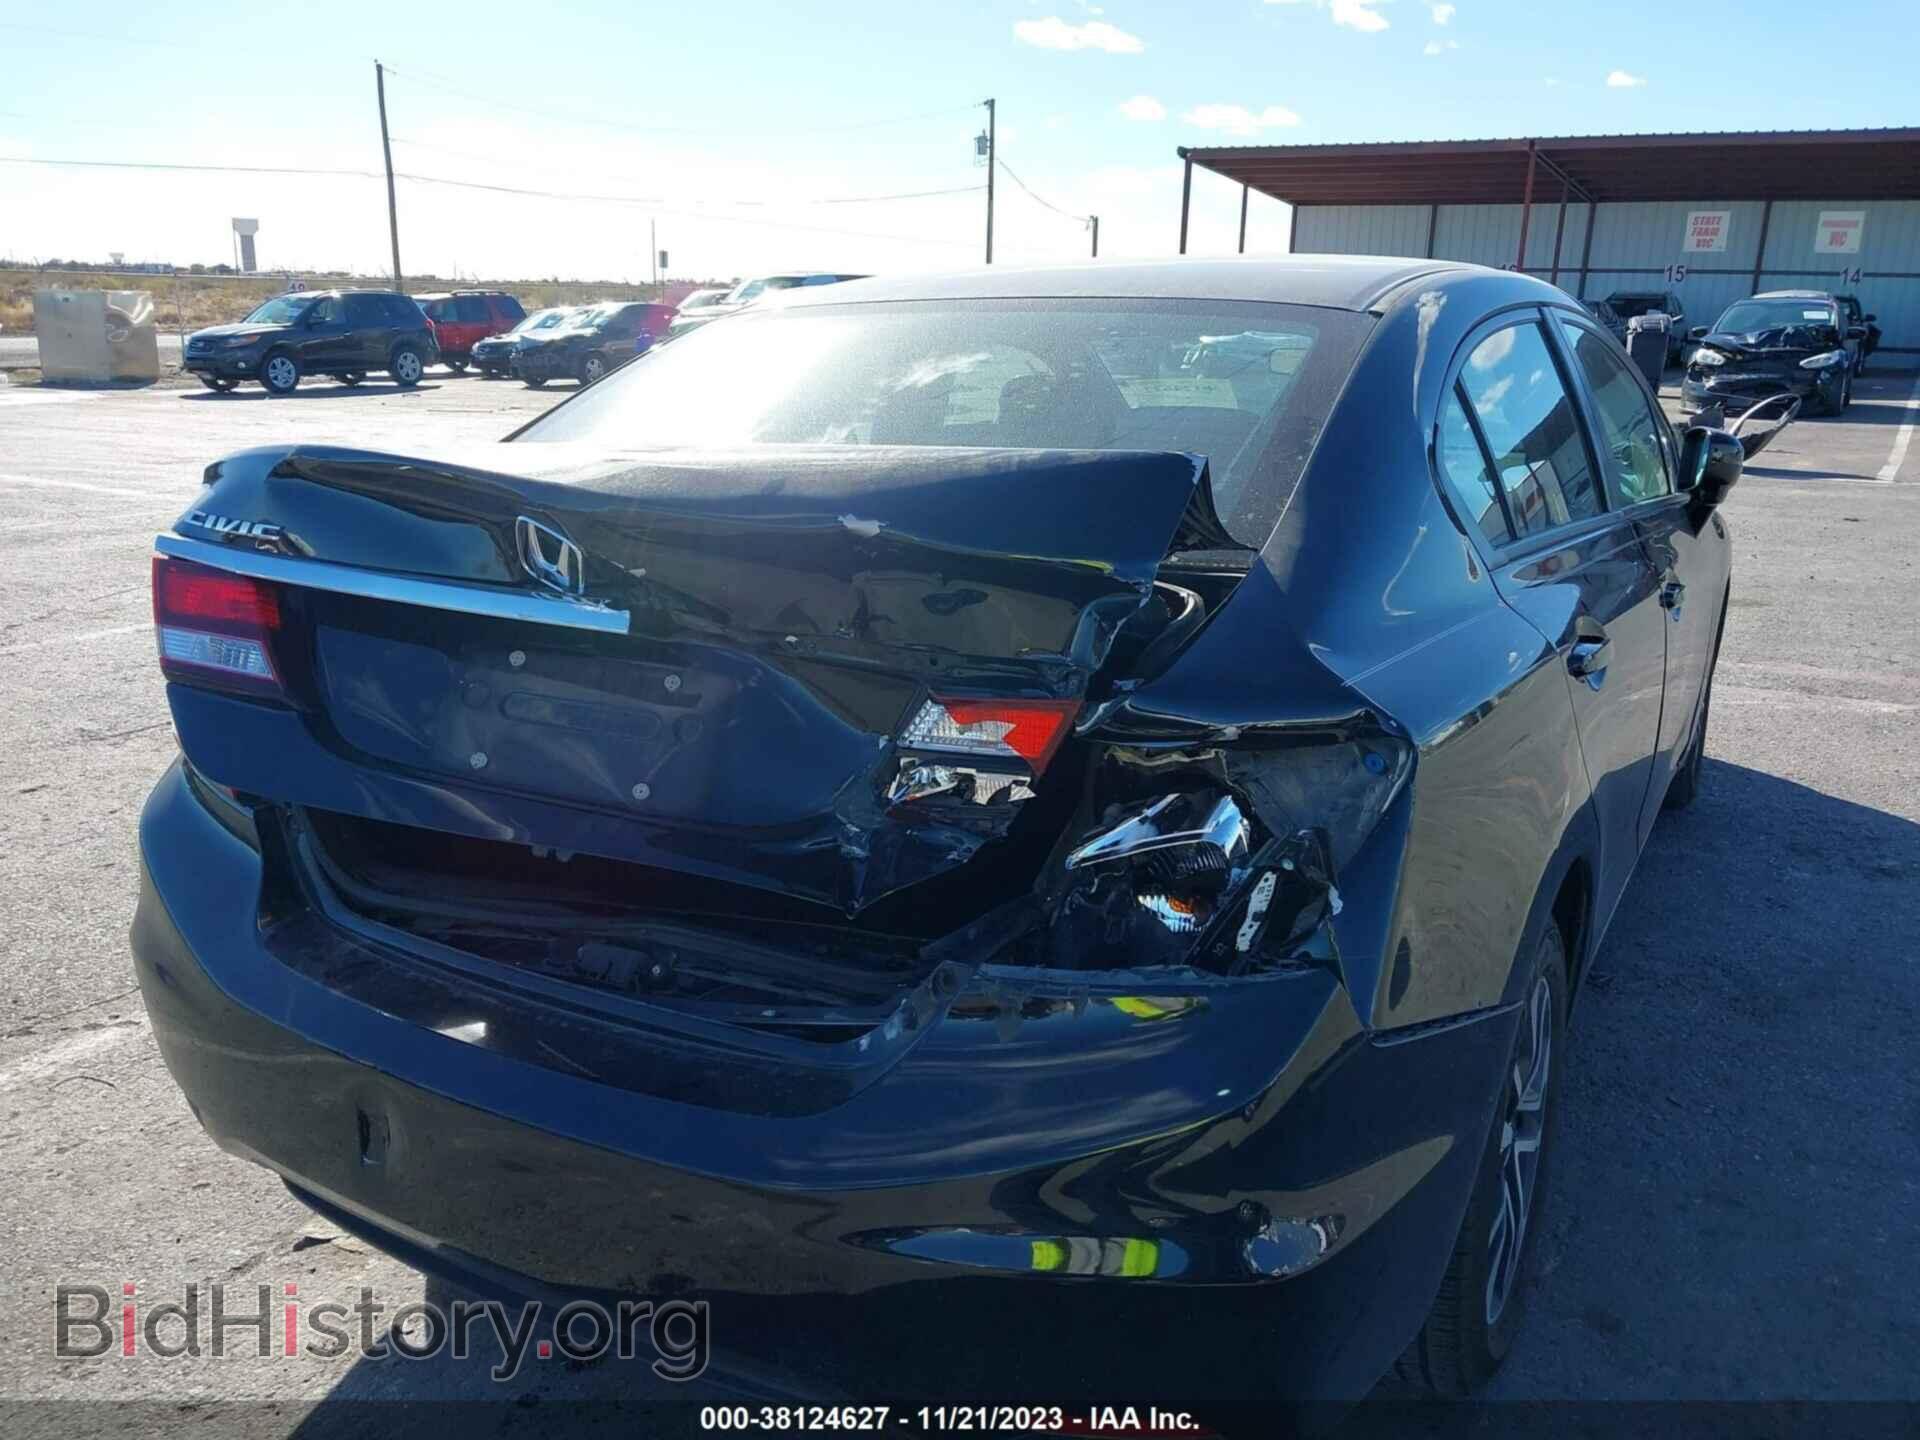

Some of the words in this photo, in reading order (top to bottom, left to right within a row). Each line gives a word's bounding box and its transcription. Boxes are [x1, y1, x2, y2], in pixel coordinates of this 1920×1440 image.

[1666, 264, 1685, 283] 15
[1840, 266, 1860, 287] 14
[183, 508, 281, 541] CIVIC
